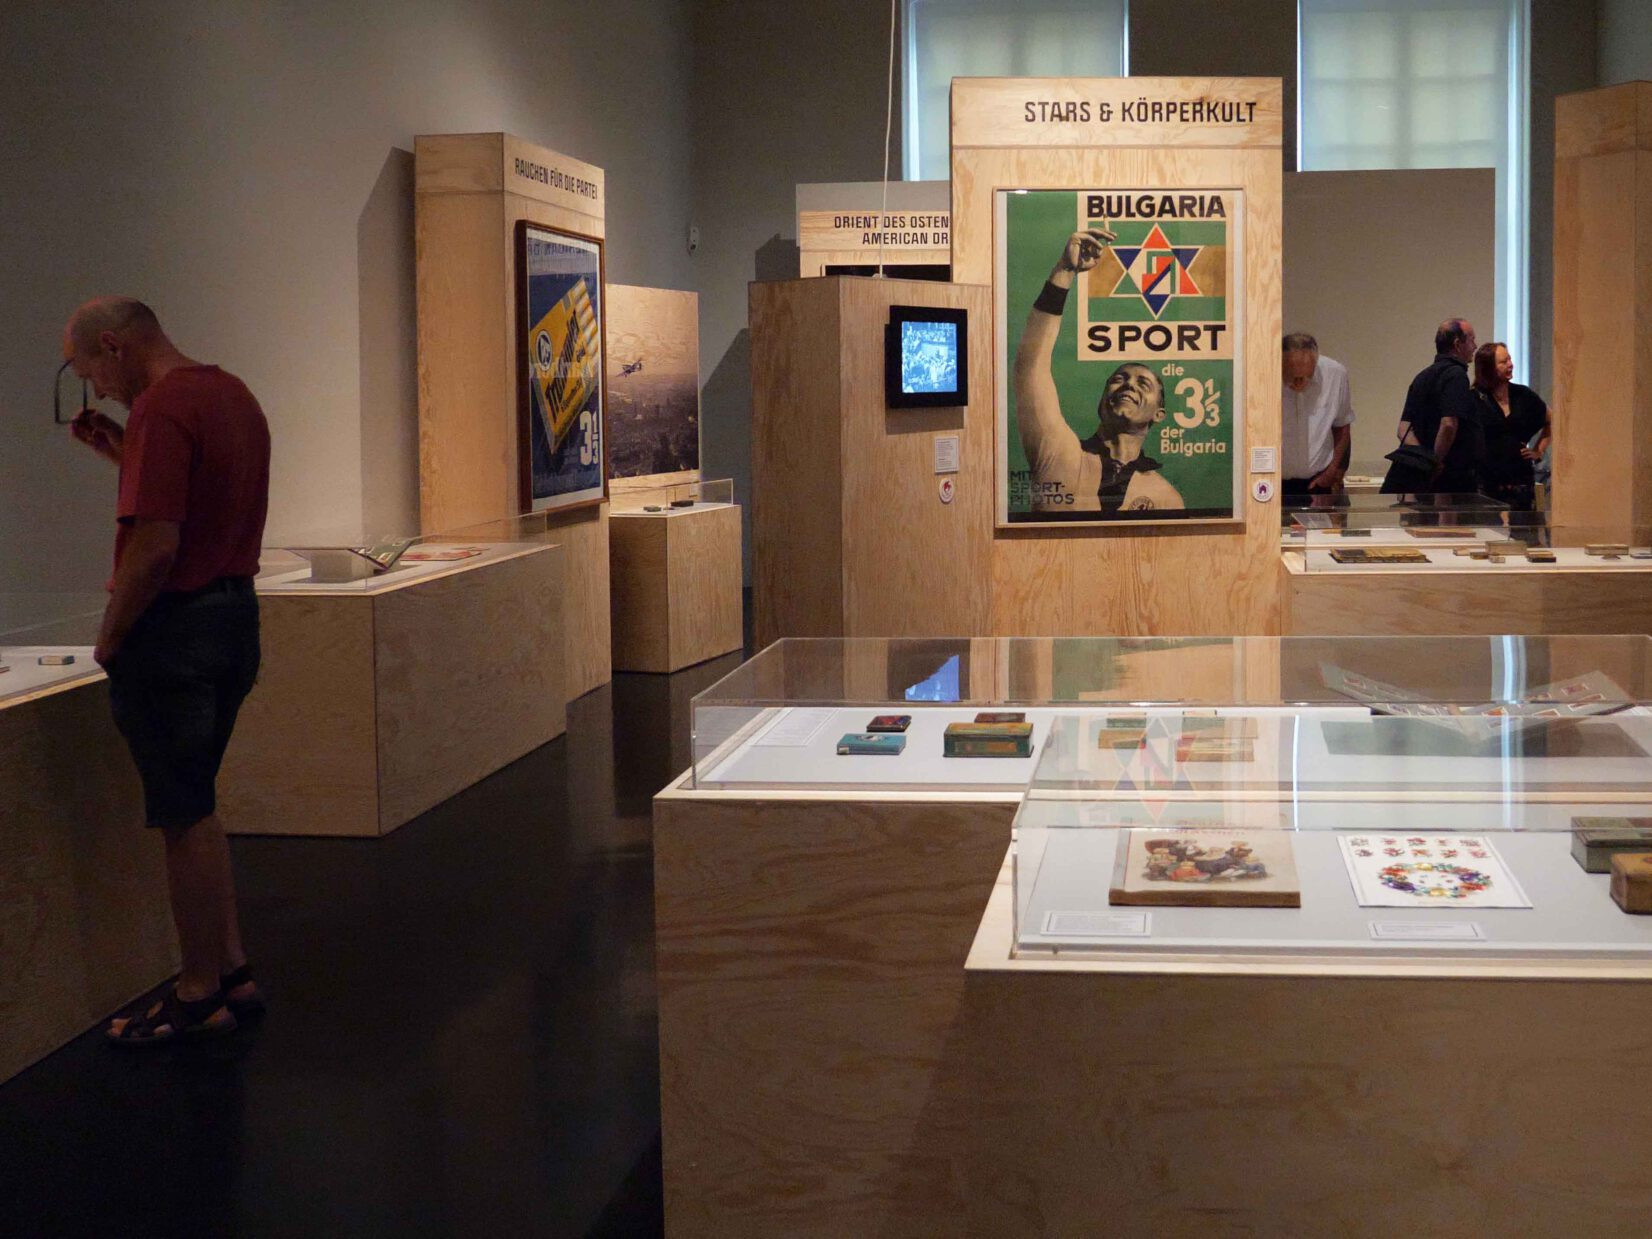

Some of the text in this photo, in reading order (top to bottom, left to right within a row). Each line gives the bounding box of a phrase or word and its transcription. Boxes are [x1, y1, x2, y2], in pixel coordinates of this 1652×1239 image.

[1024, 97, 1257, 123] STARS & KÖRPERKULT
[514, 157, 598, 200] RAUCHEN FÜR DIE PARTEI
[1086, 195, 1226, 219] BULGARIA
[834, 216, 949, 229] ORIENT DES OSTEN
[862, 232, 928, 245] AMERICAN
[1087, 324, 1226, 353] SPORT
[1161, 363, 1185, 376] die
[1160, 426, 1185, 438] der
[1160, 438, 1226, 457] Bulgaria
[1010, 482, 1066, 493] SPORT-
[1010, 493, 1075, 505] PHOTOS
